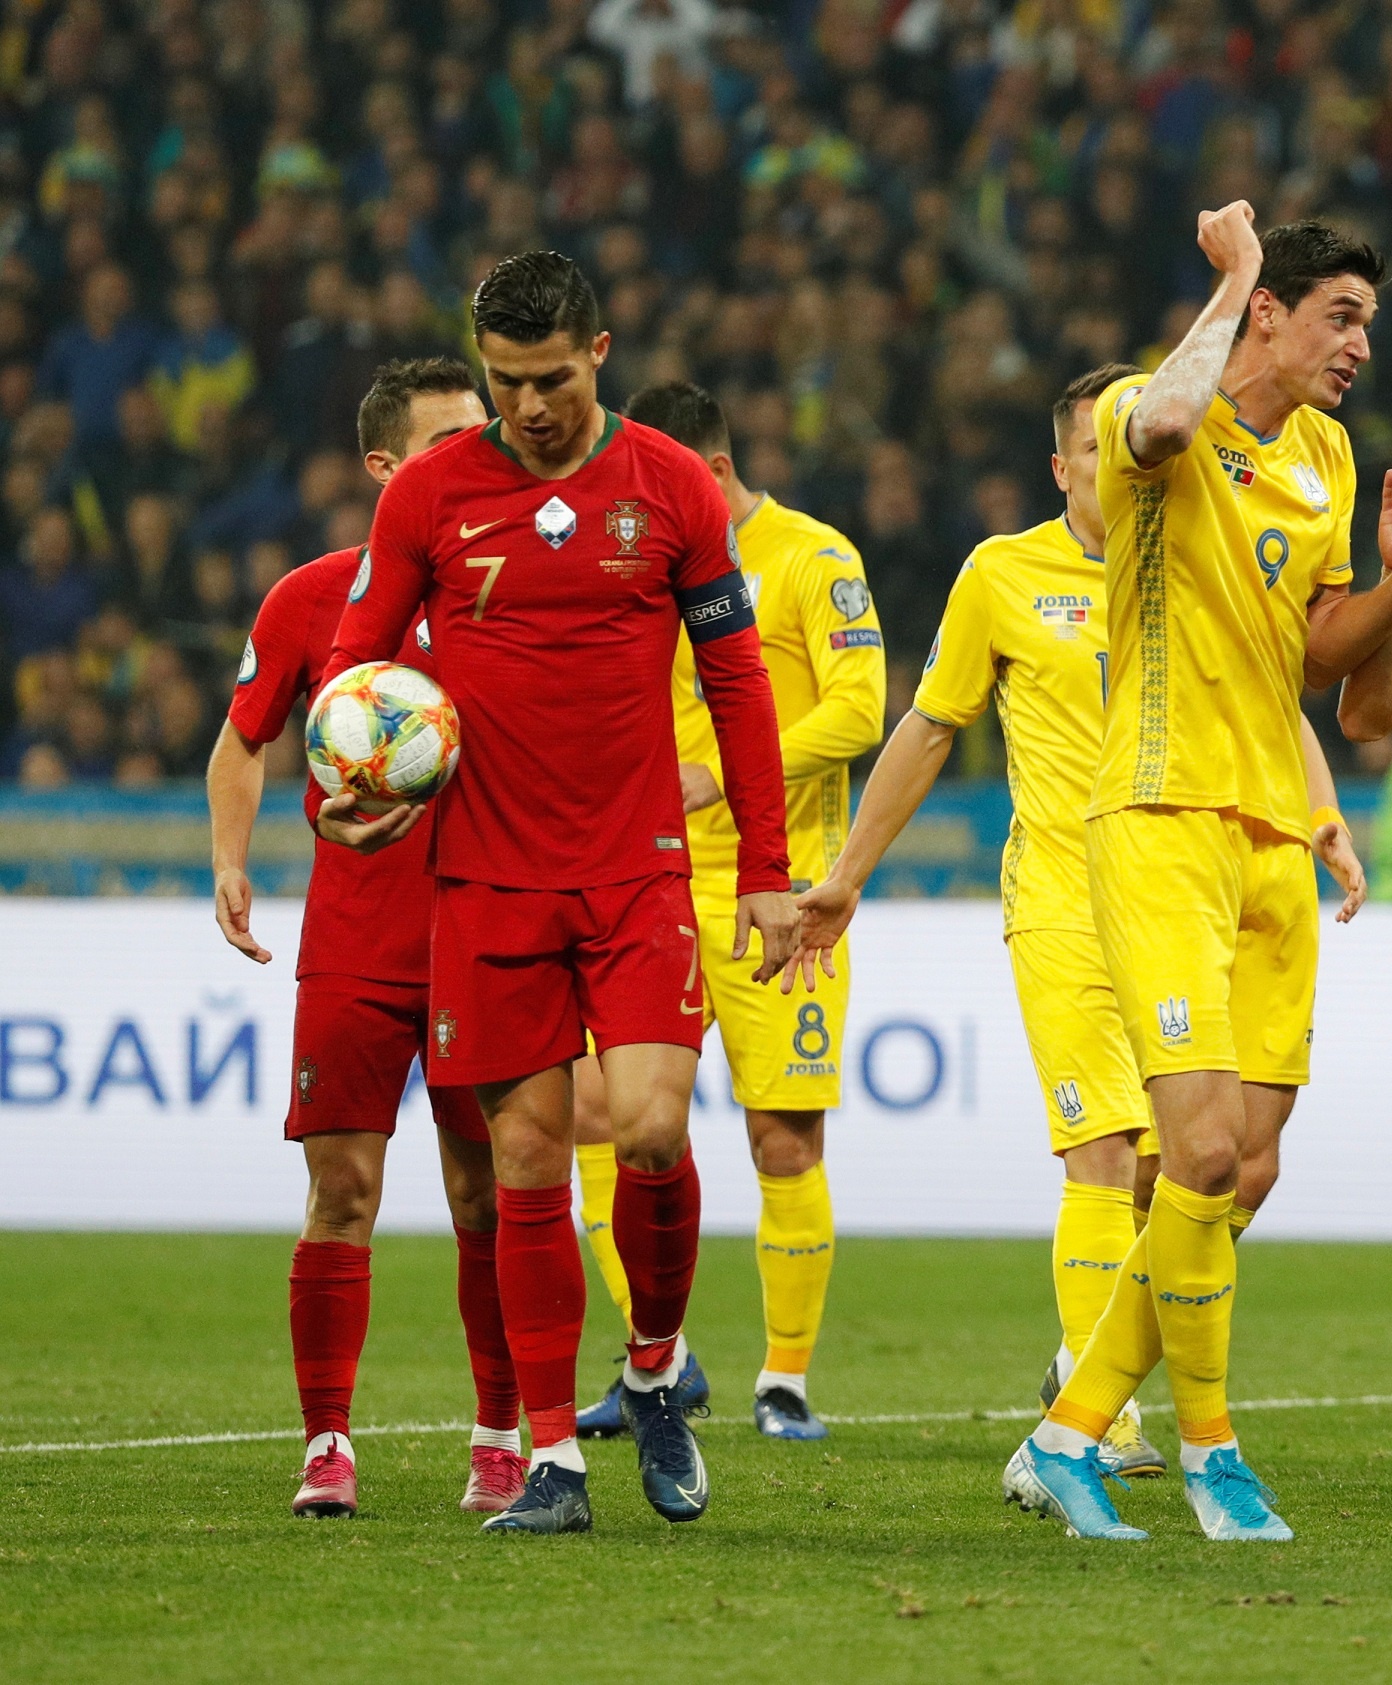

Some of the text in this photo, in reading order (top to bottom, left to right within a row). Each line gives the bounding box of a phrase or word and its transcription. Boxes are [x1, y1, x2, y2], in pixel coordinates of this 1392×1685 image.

[465, 556, 507, 621] 7
[1256, 528, 1290, 592] 9
[1096, 652, 1108, 713] 1
[678, 924, 699, 992] 7
[793, 1003, 830, 1059] 8
